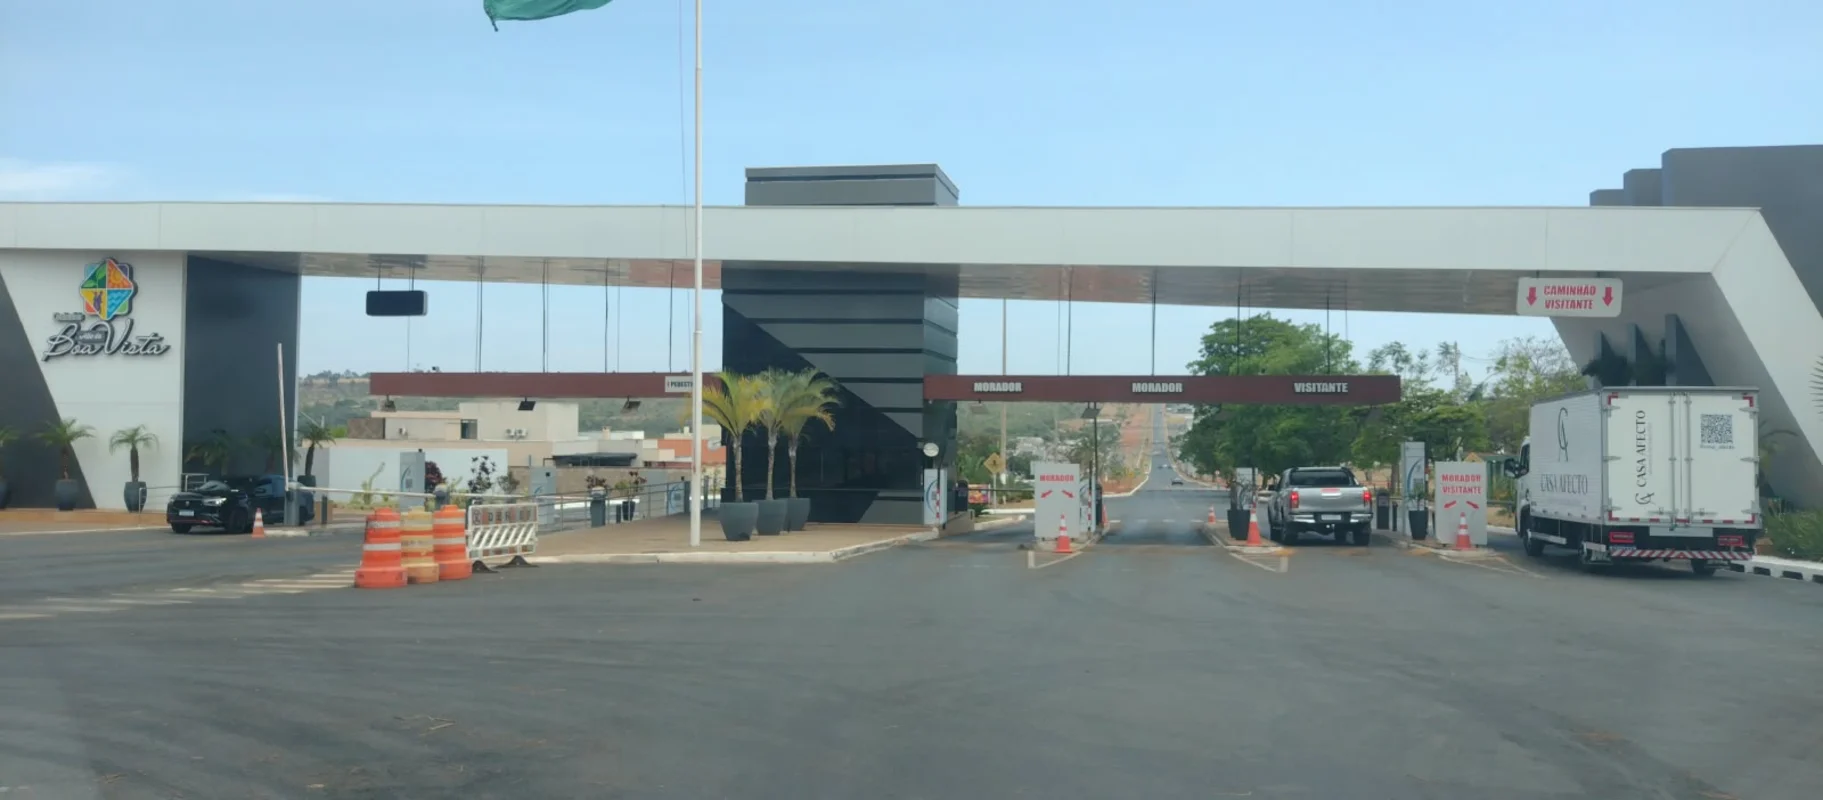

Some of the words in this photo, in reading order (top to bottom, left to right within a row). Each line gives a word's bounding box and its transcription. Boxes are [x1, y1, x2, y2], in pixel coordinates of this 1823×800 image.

[1543, 284, 1596, 296] CAMINHÃO
[1545, 299, 1593, 309] VISITANTE
[42, 322, 98, 361] Boa
[92, 318, 171, 355] Vista
[974, 382, 1022, 392] MORADOR
[1132, 382, 1183, 393] MORADOR
[1293, 382, 1349, 393] VISITANTE
[1635, 410, 1646, 455] AFECTO
[1636, 458, 1647, 487] CASA
[1441, 474, 1481, 483] MORADOR
[1540, 473, 1558, 492] CASA
[1560, 473, 1588, 495] AFECTO
[1442, 486, 1482, 494] VISITANTE
